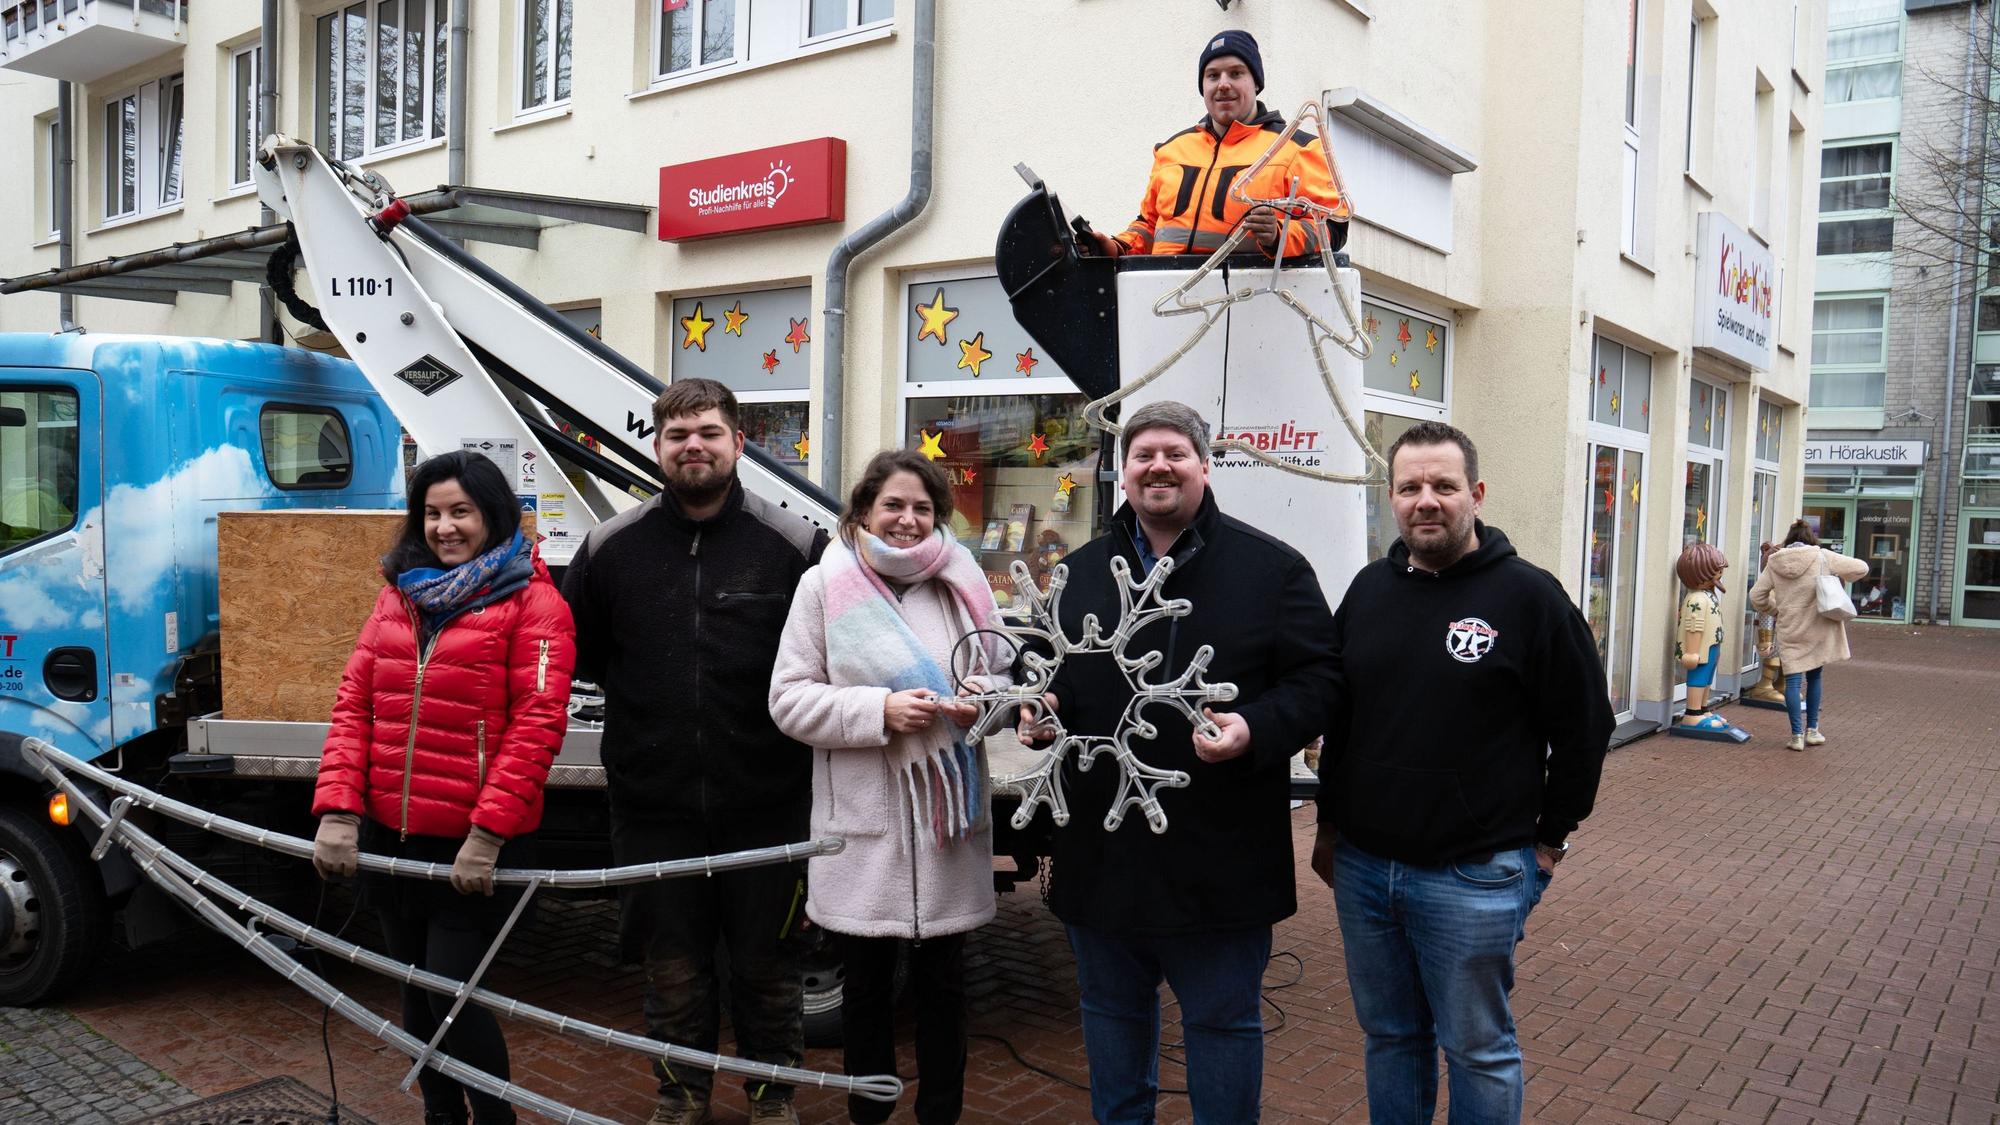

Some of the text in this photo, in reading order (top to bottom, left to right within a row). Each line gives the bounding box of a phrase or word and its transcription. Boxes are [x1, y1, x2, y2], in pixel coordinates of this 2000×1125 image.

[689, 177, 775, 207] Studienkreis
[699, 199, 766, 216] Profi-Nachhilfe für alle!
[332, 277, 341, 296] L
[1717, 308, 1745, 337] Spielwaren
[1746, 324, 1755, 343] und
[404, 370, 440, 380] VERSALIFT
[1830, 445, 1908, 461] Hörakustik
[1883, 516, 1892, 524] gut
[1893, 515, 1910, 523] hören
[988, 574, 1013, 584] CATAN
[1040, 575, 1051, 584] CAT
